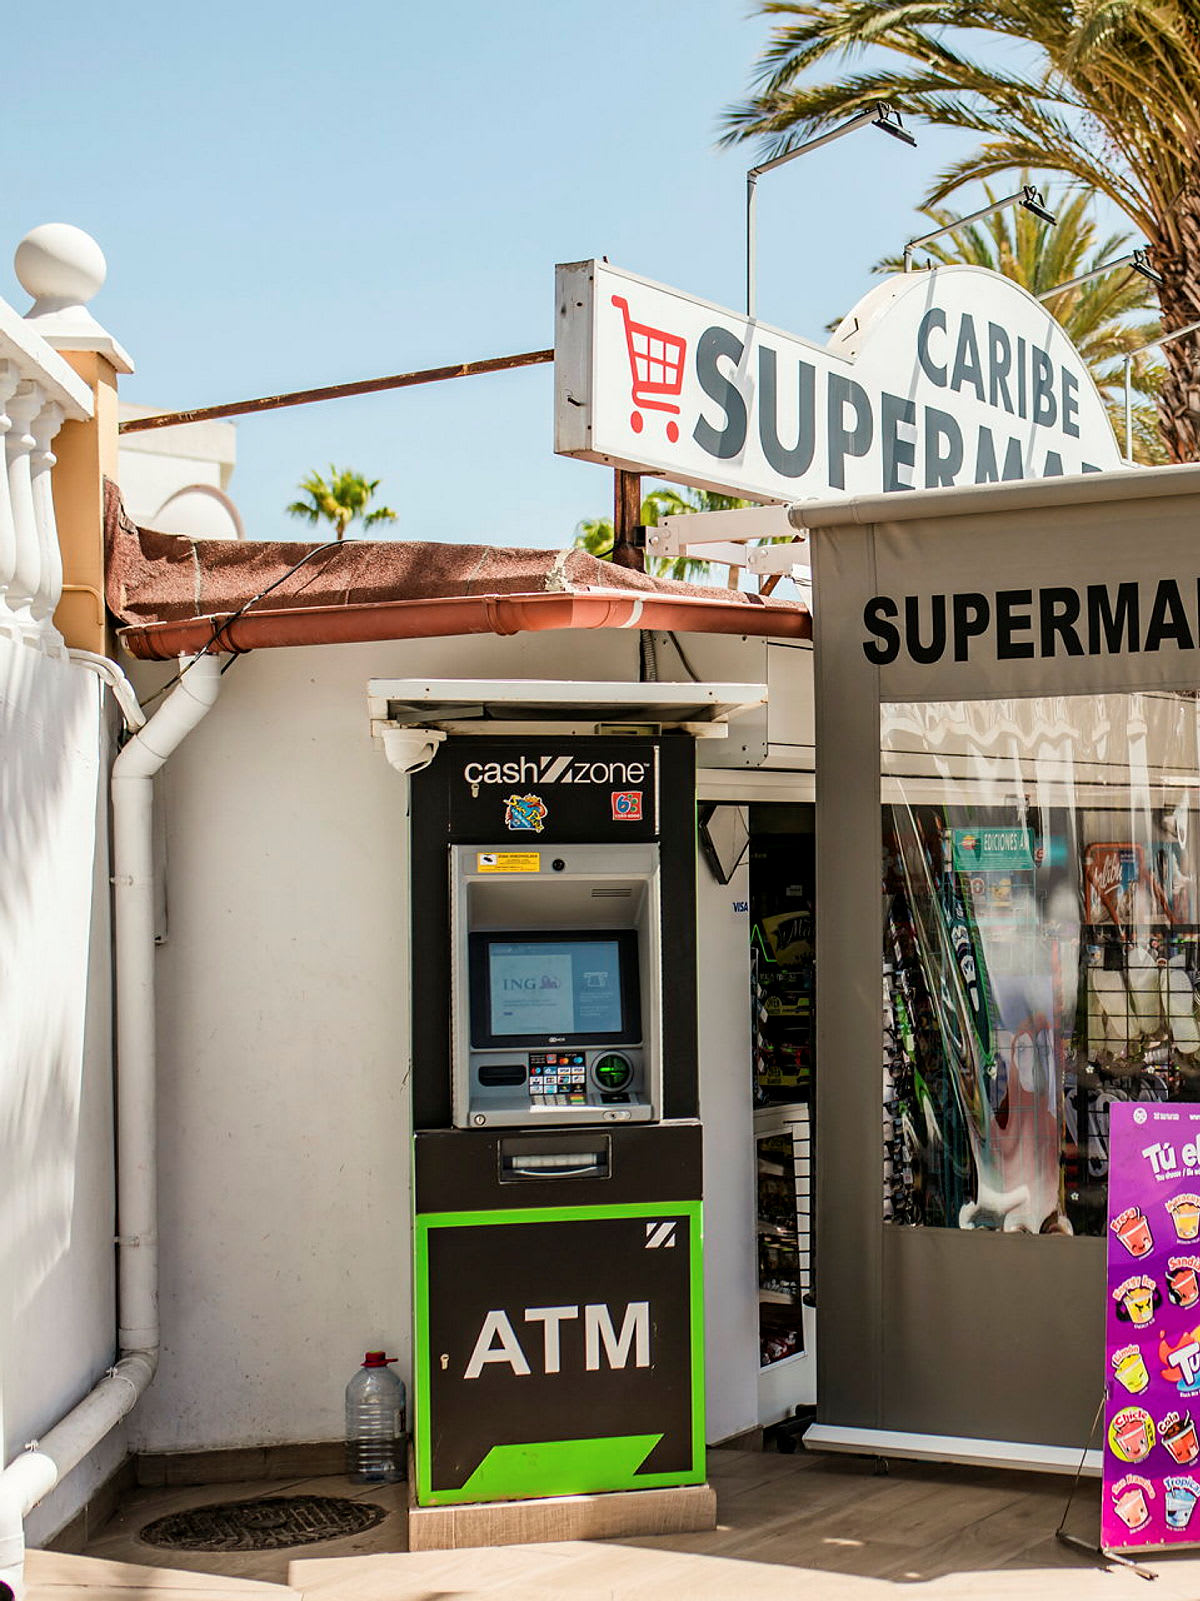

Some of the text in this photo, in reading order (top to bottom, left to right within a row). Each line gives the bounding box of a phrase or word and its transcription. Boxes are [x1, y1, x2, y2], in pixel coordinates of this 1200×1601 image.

[918, 308, 1080, 438] CARIBE
[693, 326, 1102, 492] SUPERM
[464, 756, 645, 784] cash zone
[984, 833, 1017, 851] EDICIONES
[732, 902, 748, 912] VISA
[503, 979, 536, 991] ING
[1142, 1142, 1177, 1174] Tú
[1111, 1208, 1137, 1232] Fresa
[463, 1301, 651, 1379] ATM
[1114, 1409, 1148, 1426] Chicle
[1157, 1412, 1180, 1434] Cola
